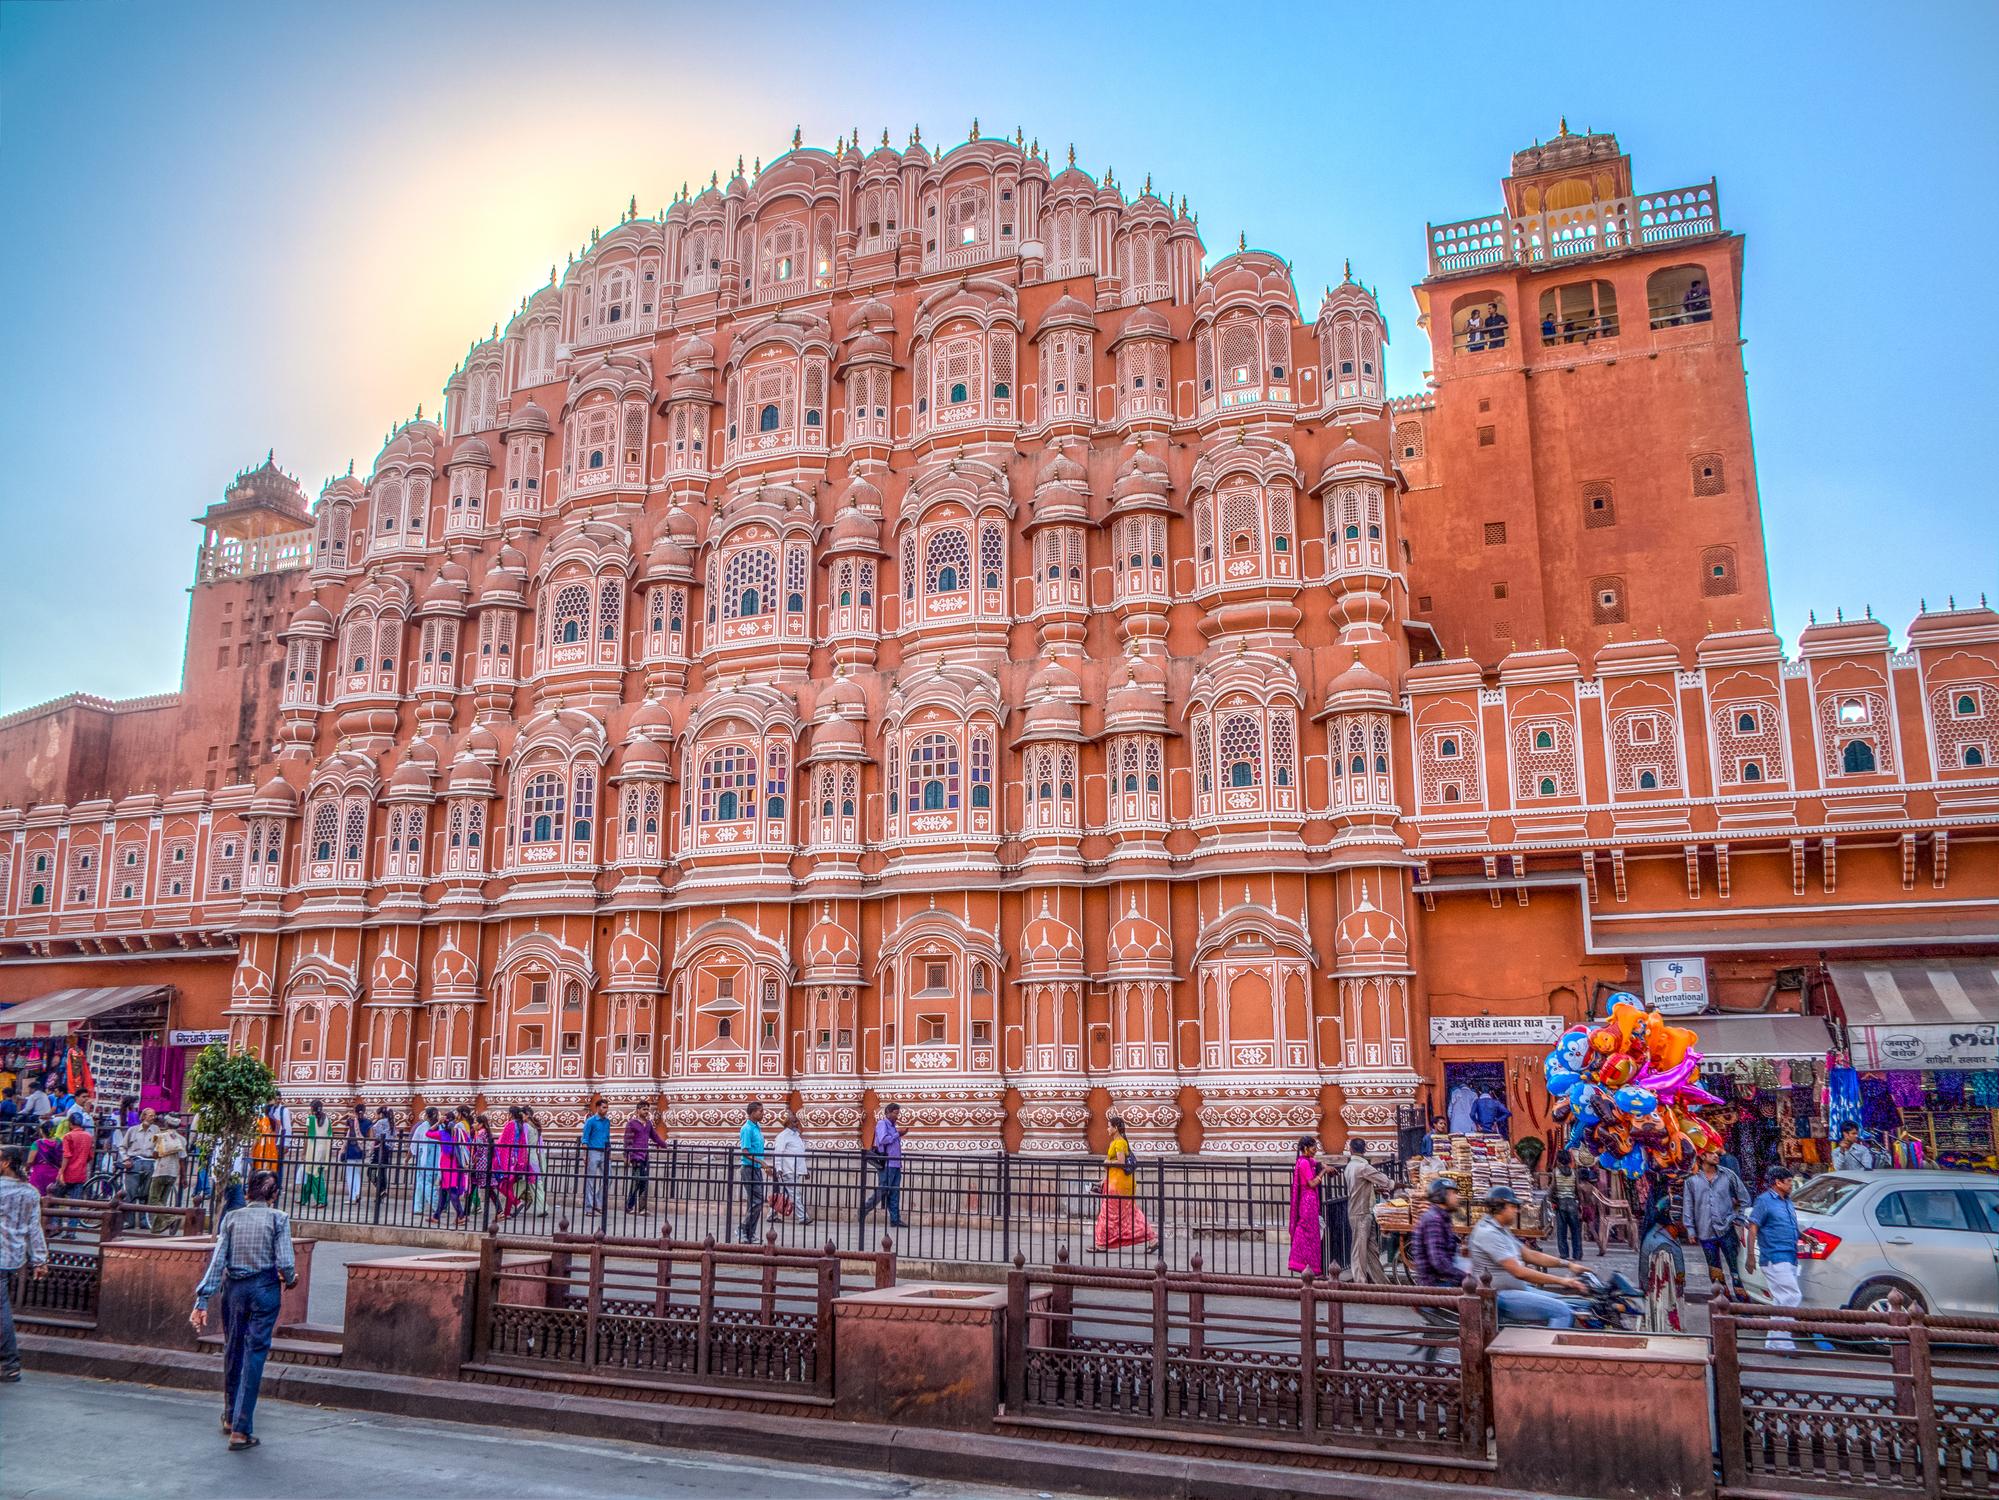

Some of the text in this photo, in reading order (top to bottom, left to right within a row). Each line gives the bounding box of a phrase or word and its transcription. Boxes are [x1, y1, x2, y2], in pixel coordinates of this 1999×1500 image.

[1654, 993, 1704, 1003] International
[1451, 1018, 1543, 1031] अर्जुनसिंह तलवार साज
[1885, 1039, 1920, 1049] जयपुरी
